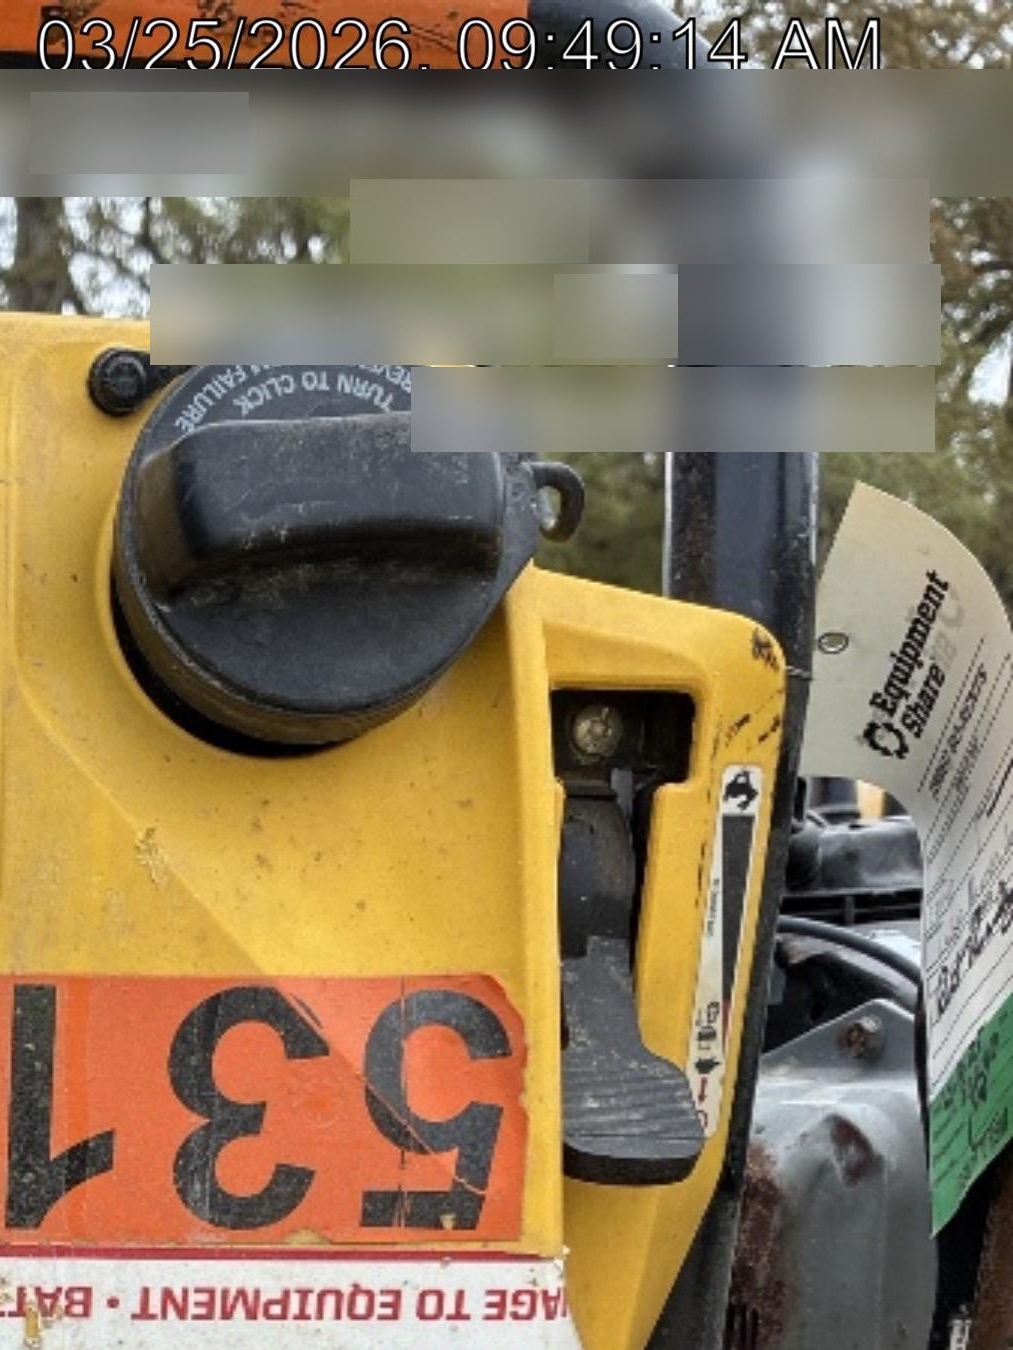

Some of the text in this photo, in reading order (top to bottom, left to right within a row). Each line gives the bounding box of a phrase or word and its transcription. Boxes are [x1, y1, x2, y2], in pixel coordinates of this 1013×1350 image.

[175, 365, 249, 433] FAILURE
[233, 371, 395, 418] TURN TO CLICK
[869, 569, 950, 718] Equipment
[900, 662, 946, 740] Share
[132, 1285, 402, 1321] EQUIPMENT
[416, 1287, 471, 1320] TO
